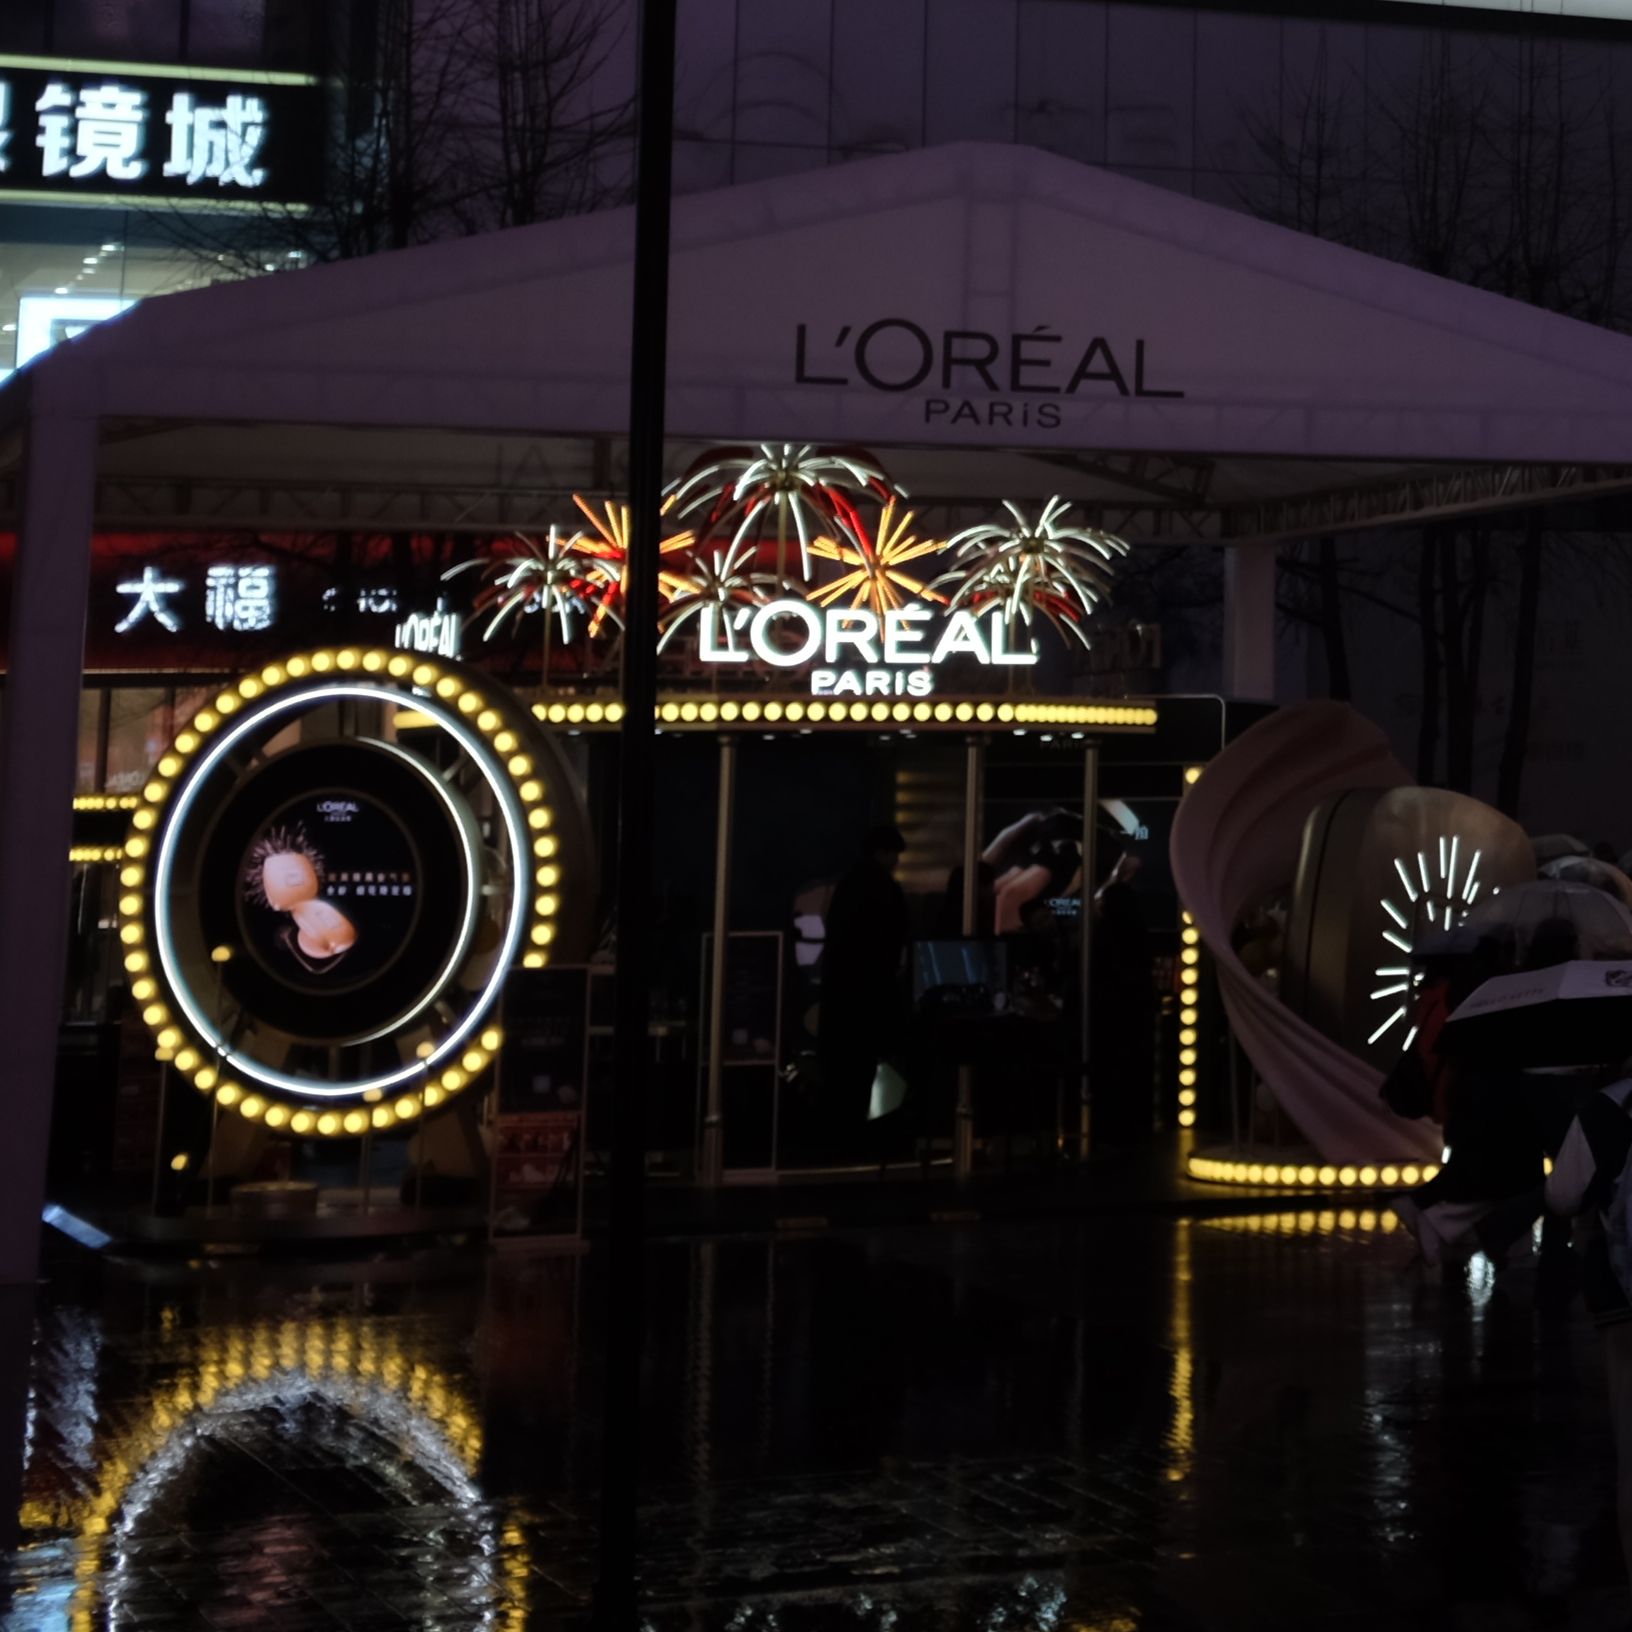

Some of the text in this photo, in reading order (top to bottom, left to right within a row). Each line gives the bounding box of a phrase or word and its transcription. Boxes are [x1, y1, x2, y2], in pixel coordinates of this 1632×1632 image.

[0, 81, 269, 188] 镜城
[795, 319, 1185, 399] L'ORÉAL
[699, 600, 1040, 667] L'ORÉAL
